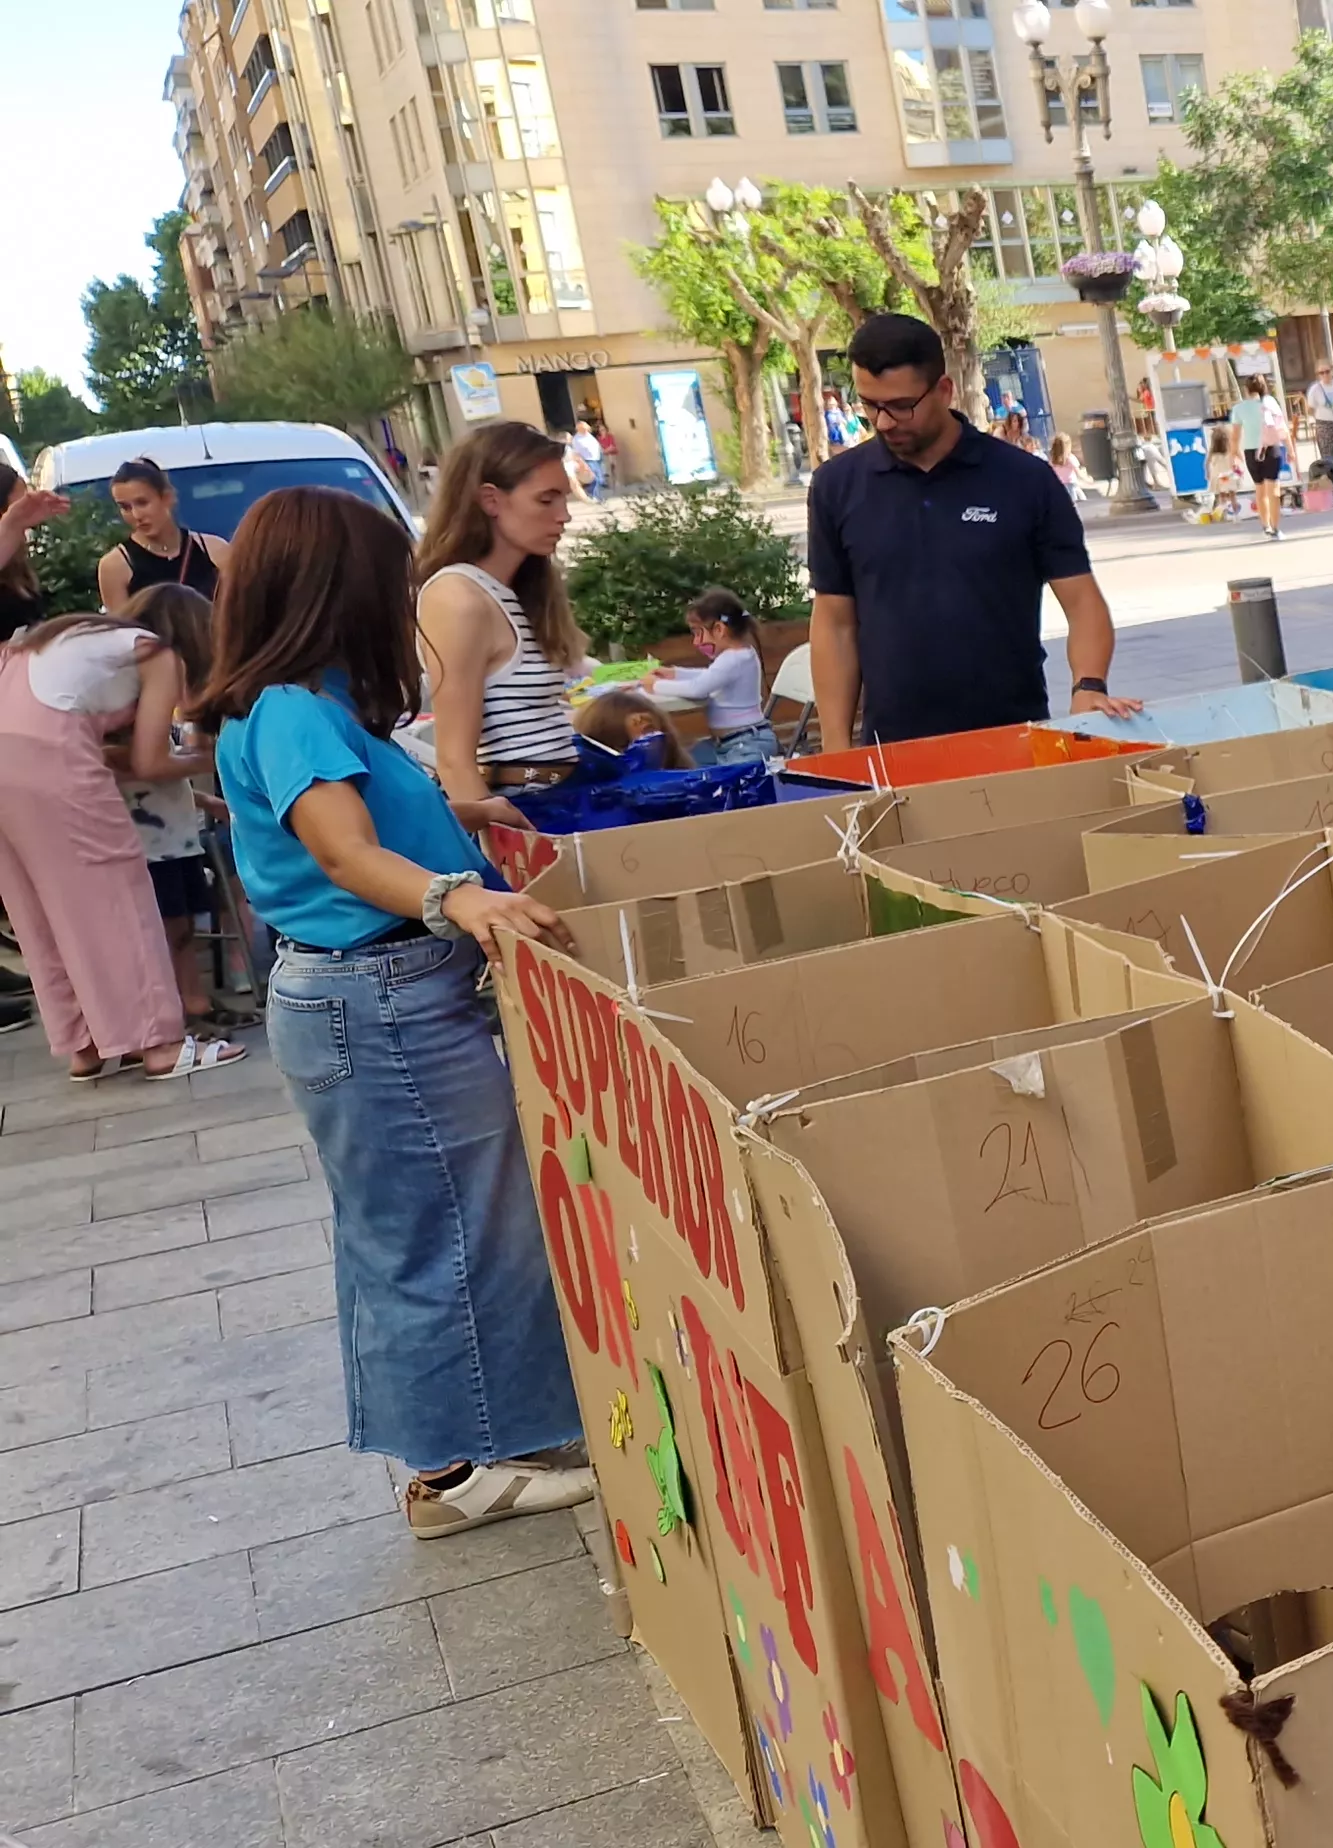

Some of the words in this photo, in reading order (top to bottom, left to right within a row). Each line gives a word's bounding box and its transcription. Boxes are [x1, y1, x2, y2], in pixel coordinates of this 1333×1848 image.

[515, 351, 610, 373] MANGO
[961, 506, 998, 523] Ford
[969, 788, 994, 818] 7
[620, 839, 640, 873] 6
[726, 1004, 767, 1065] 16
[514, 938, 745, 1313] SUPERIOR
[979, 1121, 1049, 1214] 21
[1020, 1320, 1121, 1431] 26
